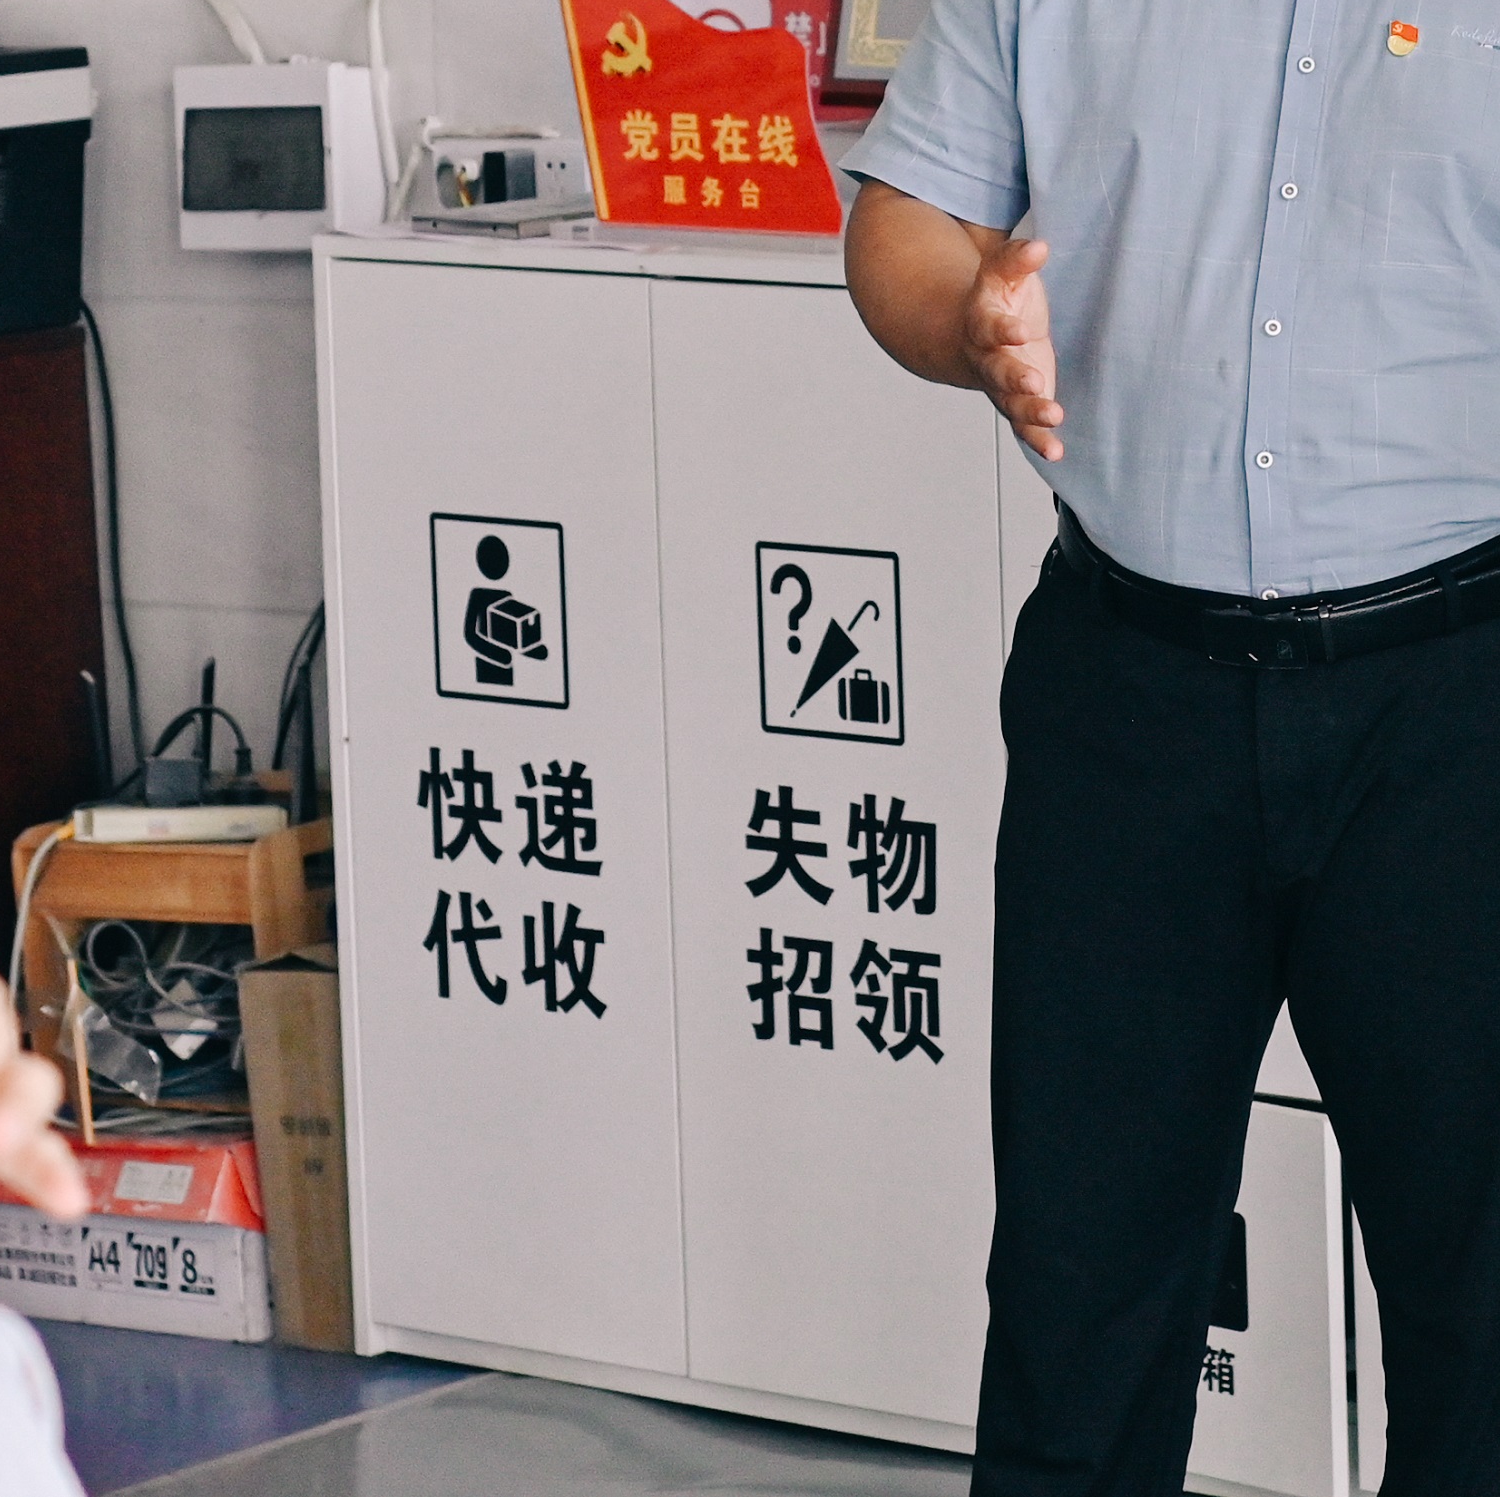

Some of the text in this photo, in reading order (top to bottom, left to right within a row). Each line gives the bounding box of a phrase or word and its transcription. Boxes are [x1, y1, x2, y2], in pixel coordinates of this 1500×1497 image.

[620, 109, 799, 168] 党员在线
[663, 175, 761, 209] 服务台
[417, 747, 603, 877] 快递
[745, 785, 938, 915] 失物
[423, 889, 607, 1019] 代收
[746, 927, 944, 1065] 招领
[1203, 1345, 1236, 1396] 箱
